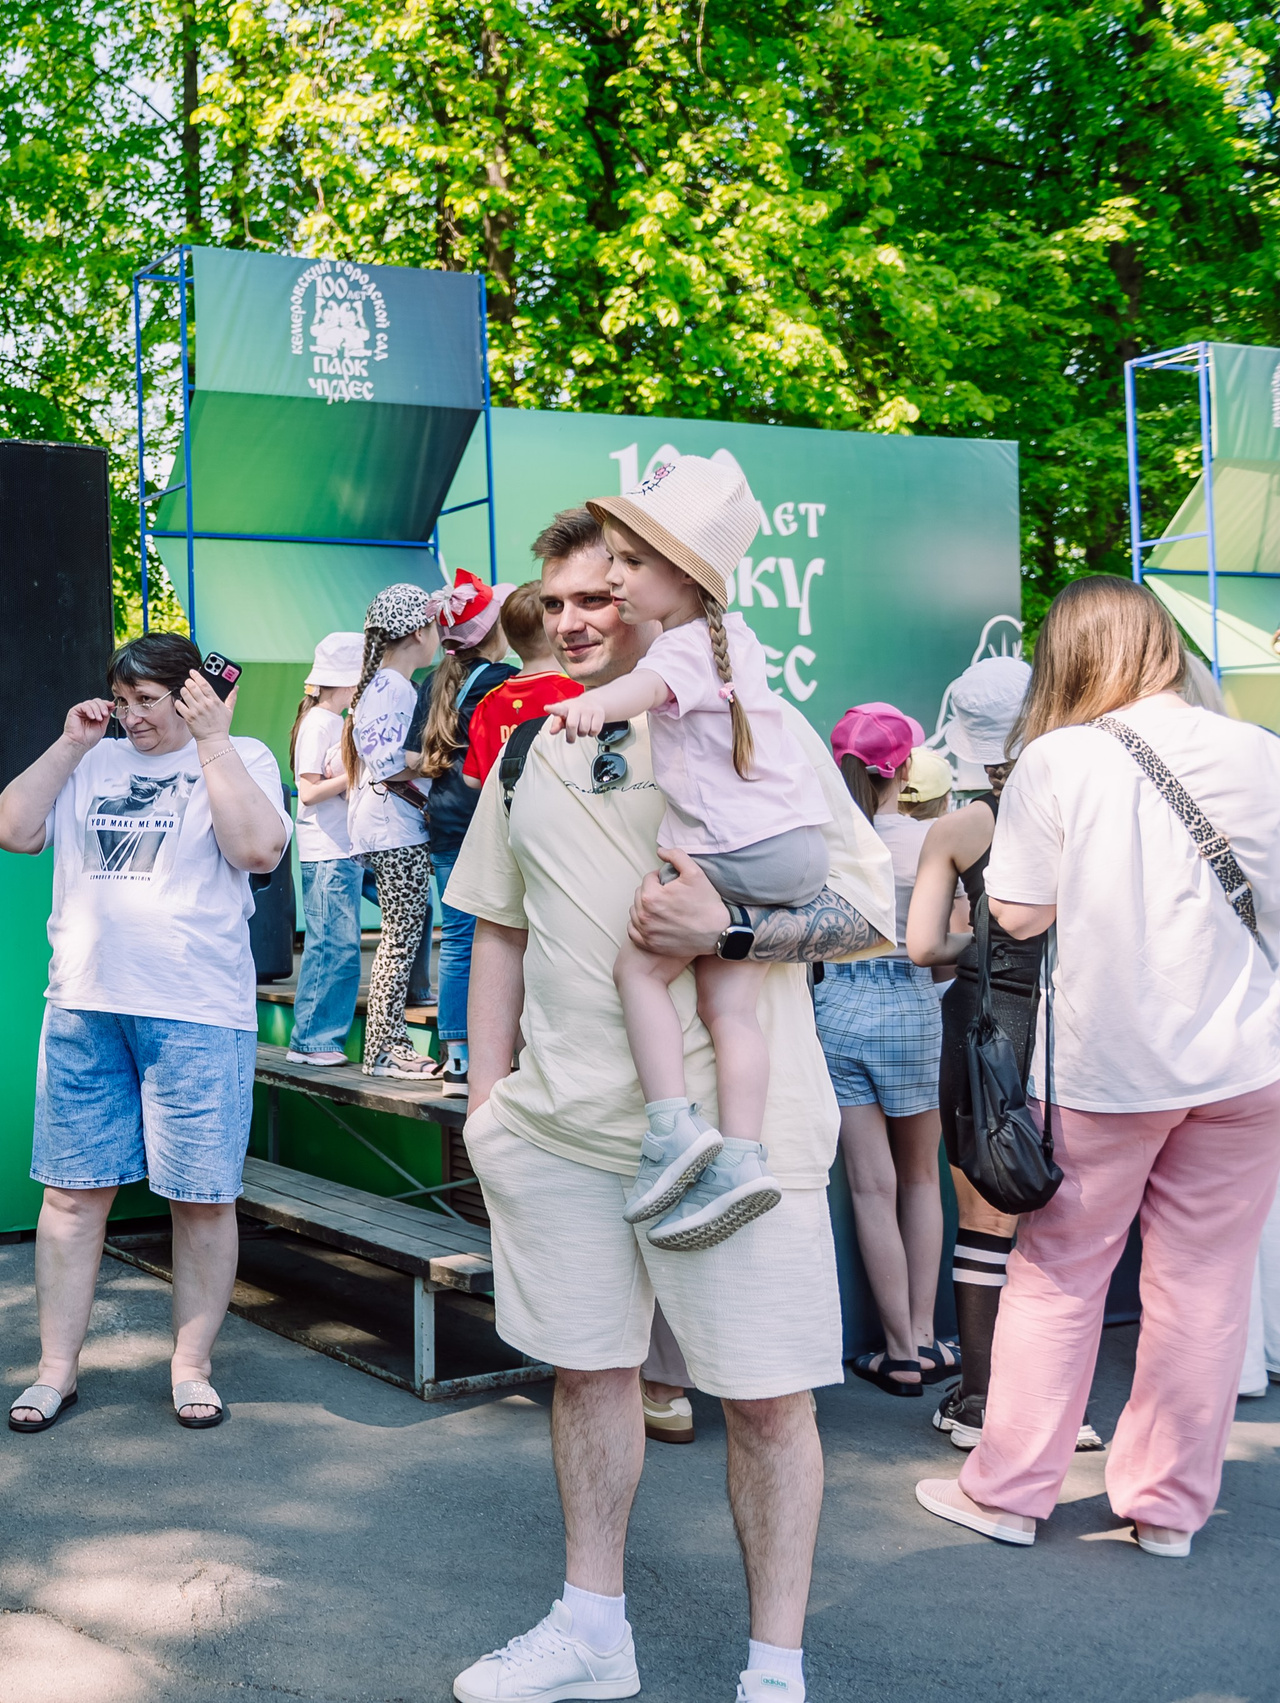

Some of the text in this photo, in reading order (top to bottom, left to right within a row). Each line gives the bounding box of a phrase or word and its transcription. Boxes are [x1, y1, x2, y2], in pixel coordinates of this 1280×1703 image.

[316, 275, 349, 299] 100
[362, 723, 403, 755] SKY
[91, 818, 175, 829] YOU MAKE ME MAD
